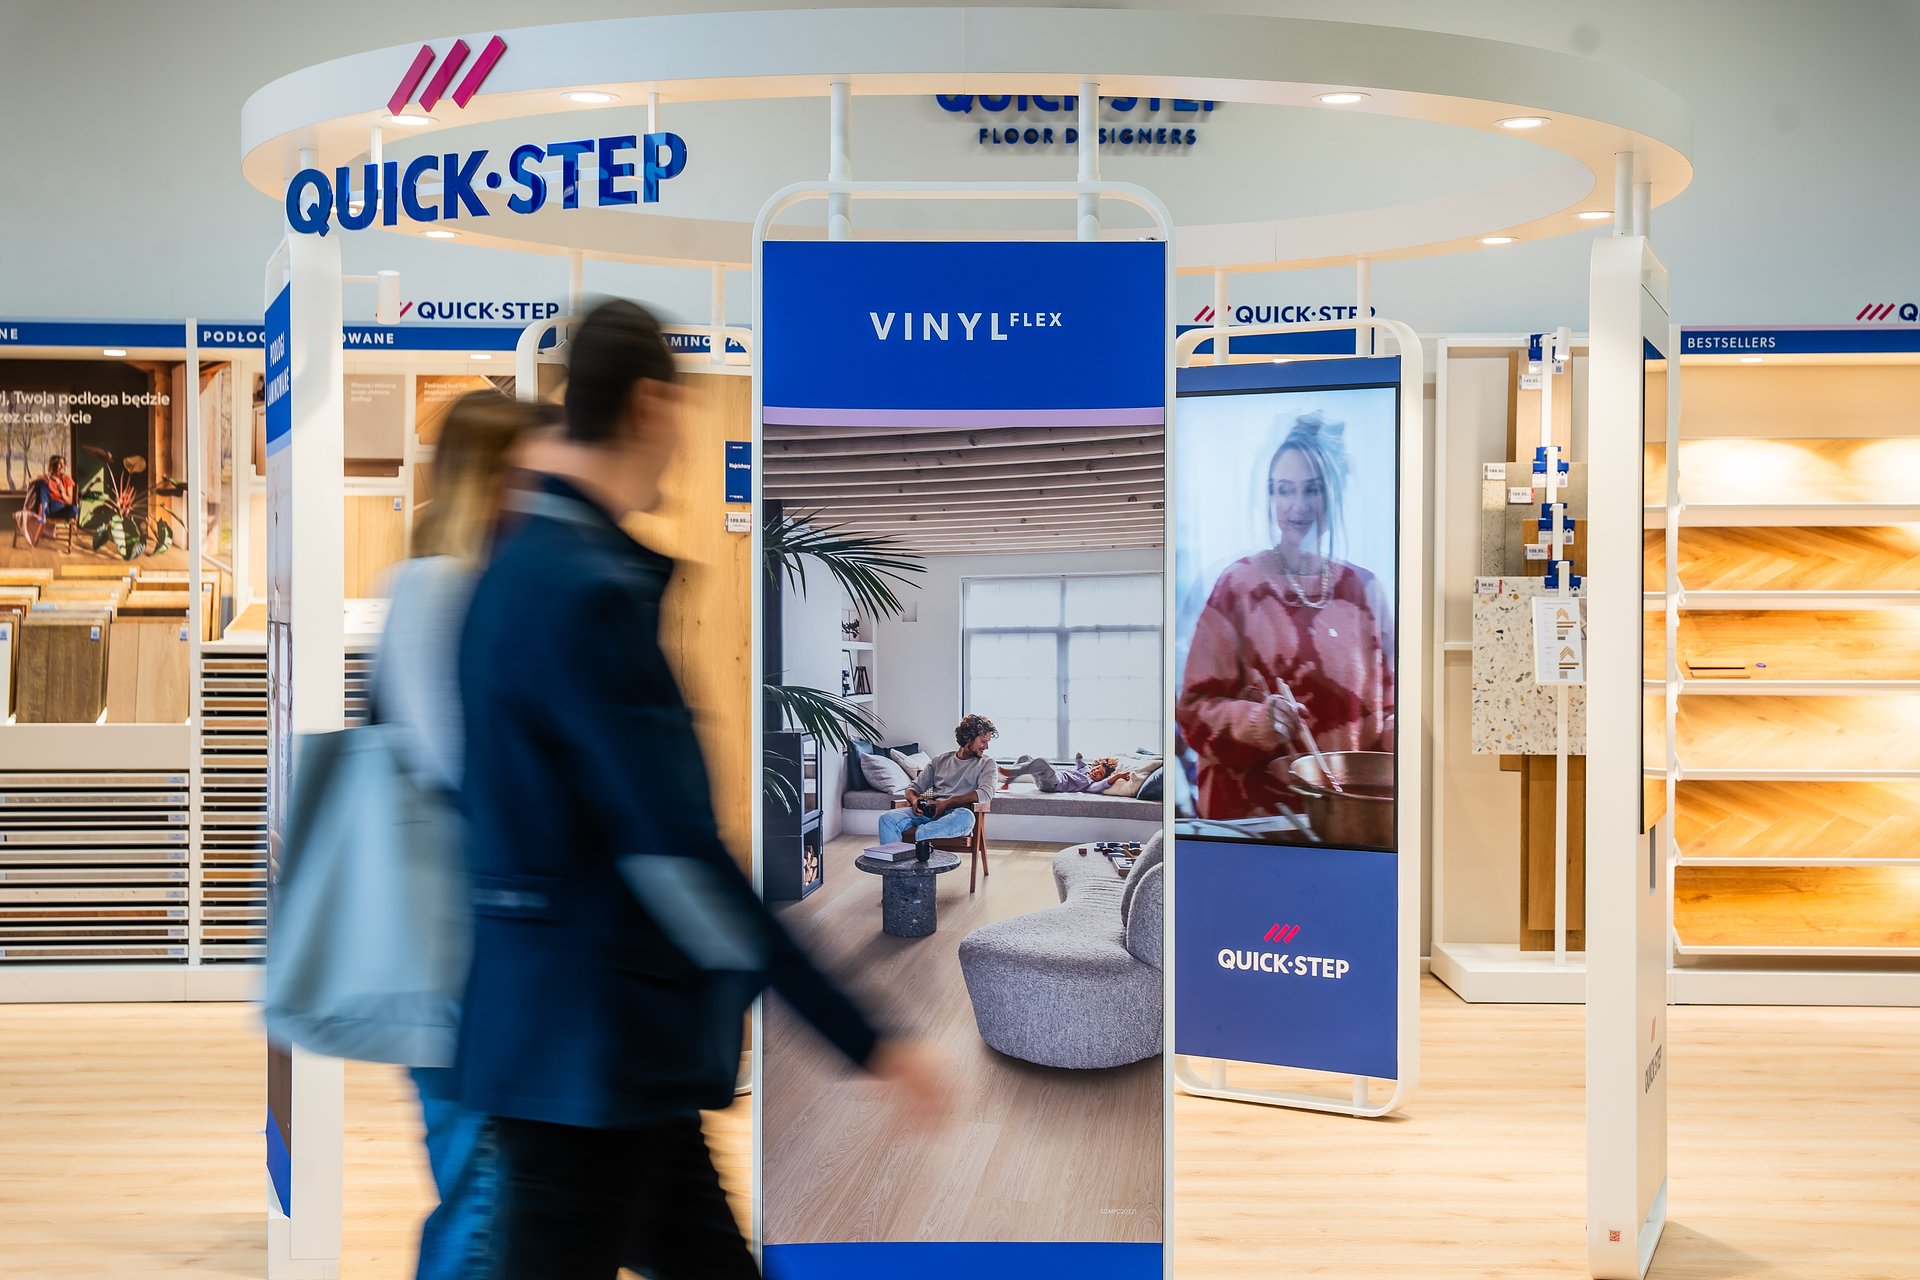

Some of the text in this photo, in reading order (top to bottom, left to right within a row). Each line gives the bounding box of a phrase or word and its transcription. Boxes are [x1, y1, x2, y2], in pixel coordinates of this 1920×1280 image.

[979, 128, 1198, 146] FLOOR DSIGNERS
[1687, 336, 1777, 349] BESTSELLERS
[14, 391, 55, 406] Twoja
[59, 391, 119, 408] podłoga
[122, 391, 170, 408] będzie
[56, 411, 92, 426] życie
